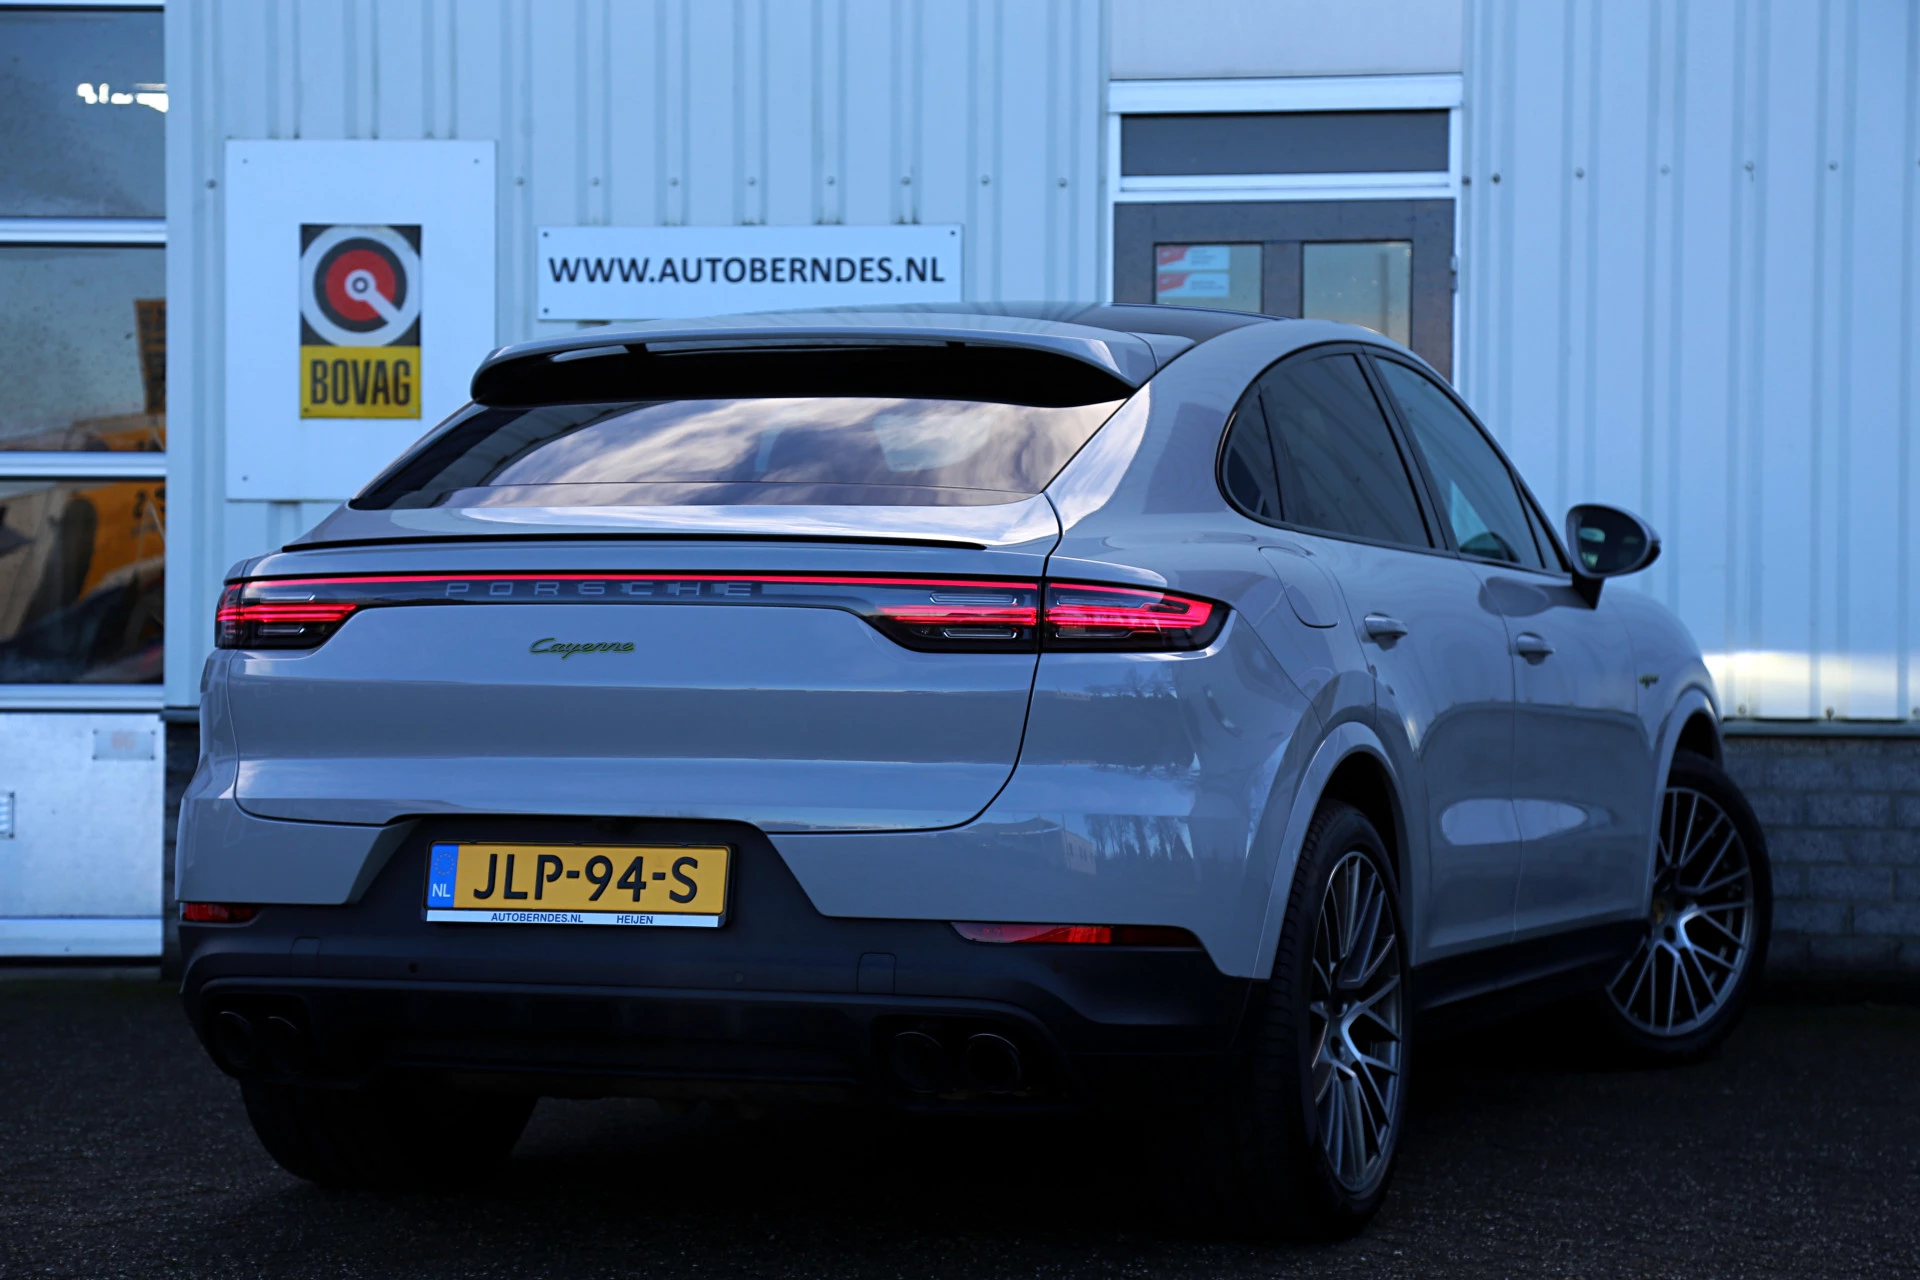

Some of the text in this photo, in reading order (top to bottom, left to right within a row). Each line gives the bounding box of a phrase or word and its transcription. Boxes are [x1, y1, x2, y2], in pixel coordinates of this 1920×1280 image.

[549, 257, 946, 283] WWW.AUTOBERNDES.NL
[310, 359, 412, 405] BOVAG
[445, 582, 753, 597] PORSCHE
[529, 637, 635, 660] Cayenne
[431, 882, 451, 898] NL
[473, 853, 699, 904] JLP-94-S
[490, 912, 654, 925] AUTOBERNDES.NL HEIJEN
